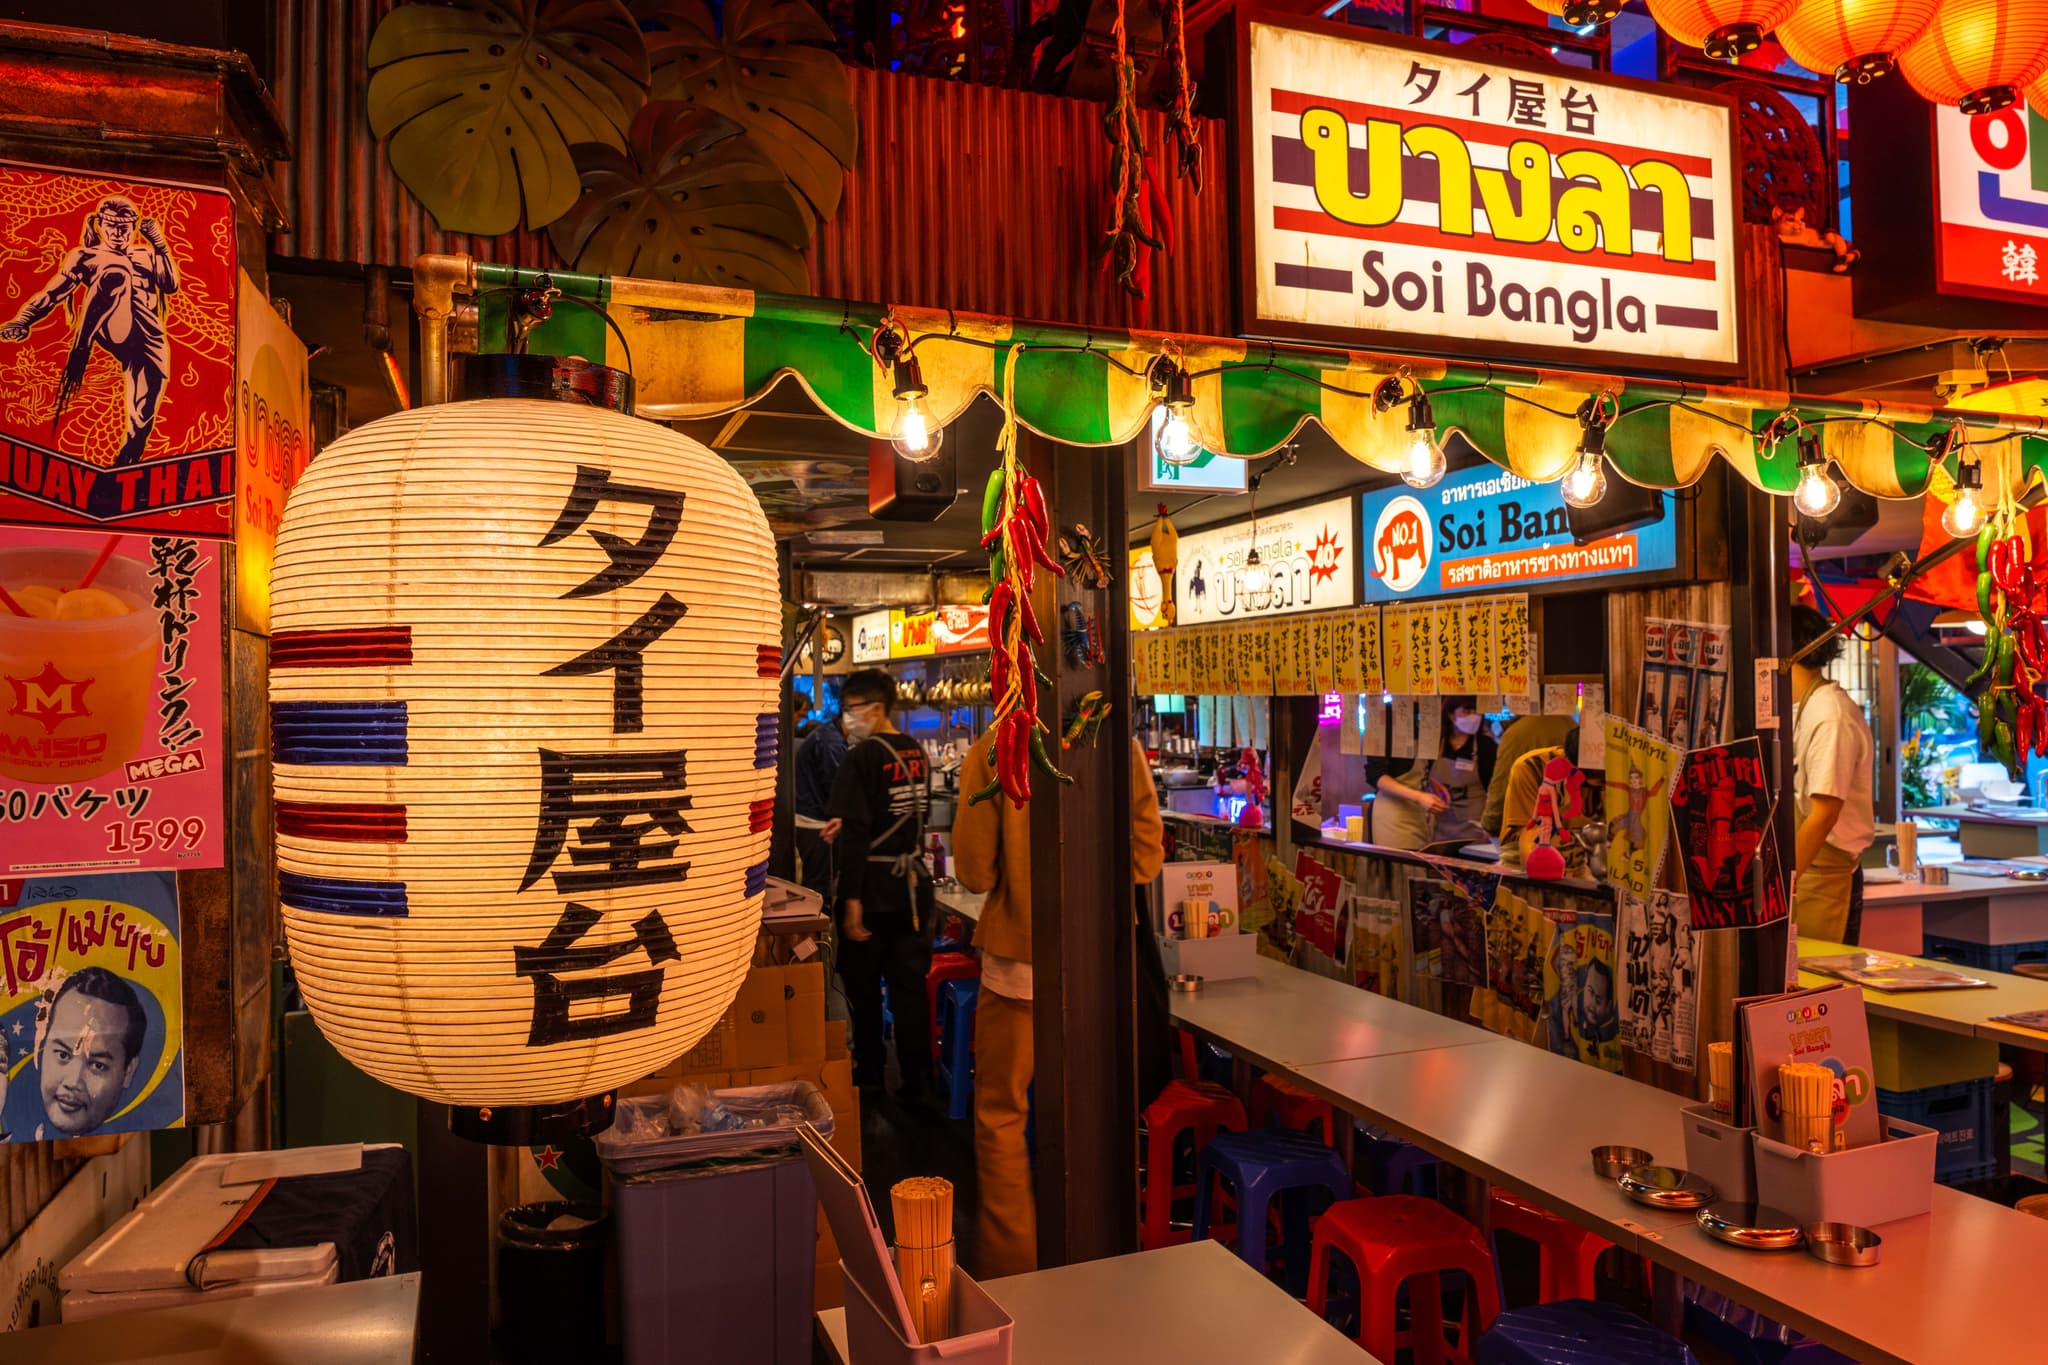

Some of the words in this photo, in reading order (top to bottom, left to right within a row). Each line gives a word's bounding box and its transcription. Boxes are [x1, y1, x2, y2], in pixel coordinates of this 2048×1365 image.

[1403, 60, 1599, 136] タイ屋台
[1300, 106, 1694, 264] บางลา
[1362, 250, 1445, 316] Soi
[1467, 261, 1647, 344] Bangla
[115, 454, 232, 513] THAI
[1256, 538, 1293, 562] angla
[1392, 519, 1418, 548] NO.1
[1439, 509, 1487, 553] Soi
[1499, 501, 1570, 543] Ban
[129, 753, 200, 780] MEGA
[515, 464, 694, 1047] タイ屋台
[105, 818, 205, 852] 1599
